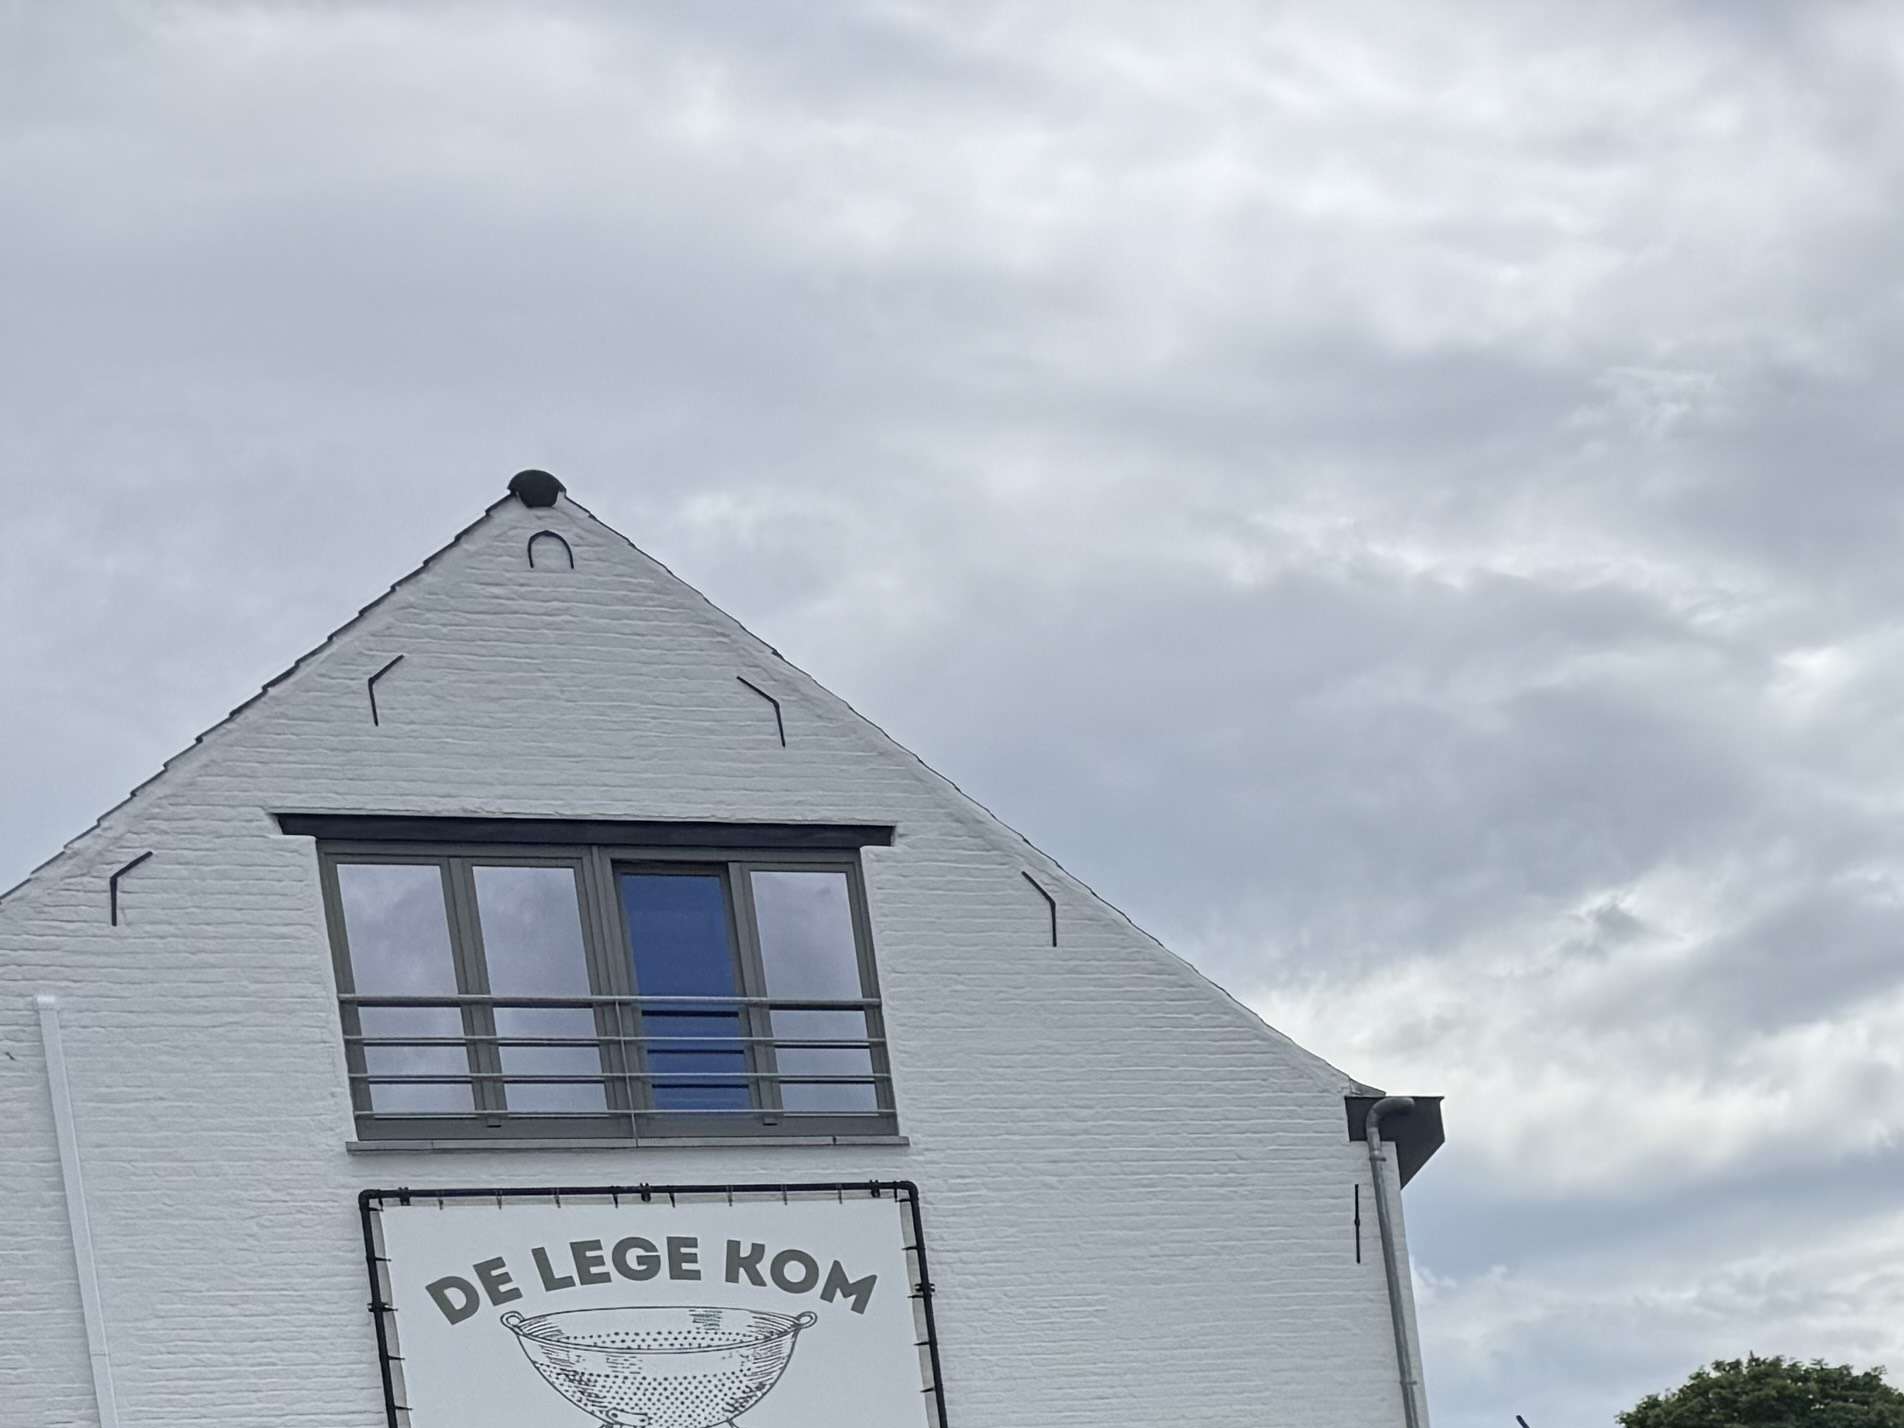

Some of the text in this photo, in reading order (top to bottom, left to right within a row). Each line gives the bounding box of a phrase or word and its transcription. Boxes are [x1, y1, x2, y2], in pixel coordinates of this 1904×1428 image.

[426, 1236, 878, 1325] DE LEGE KOM
